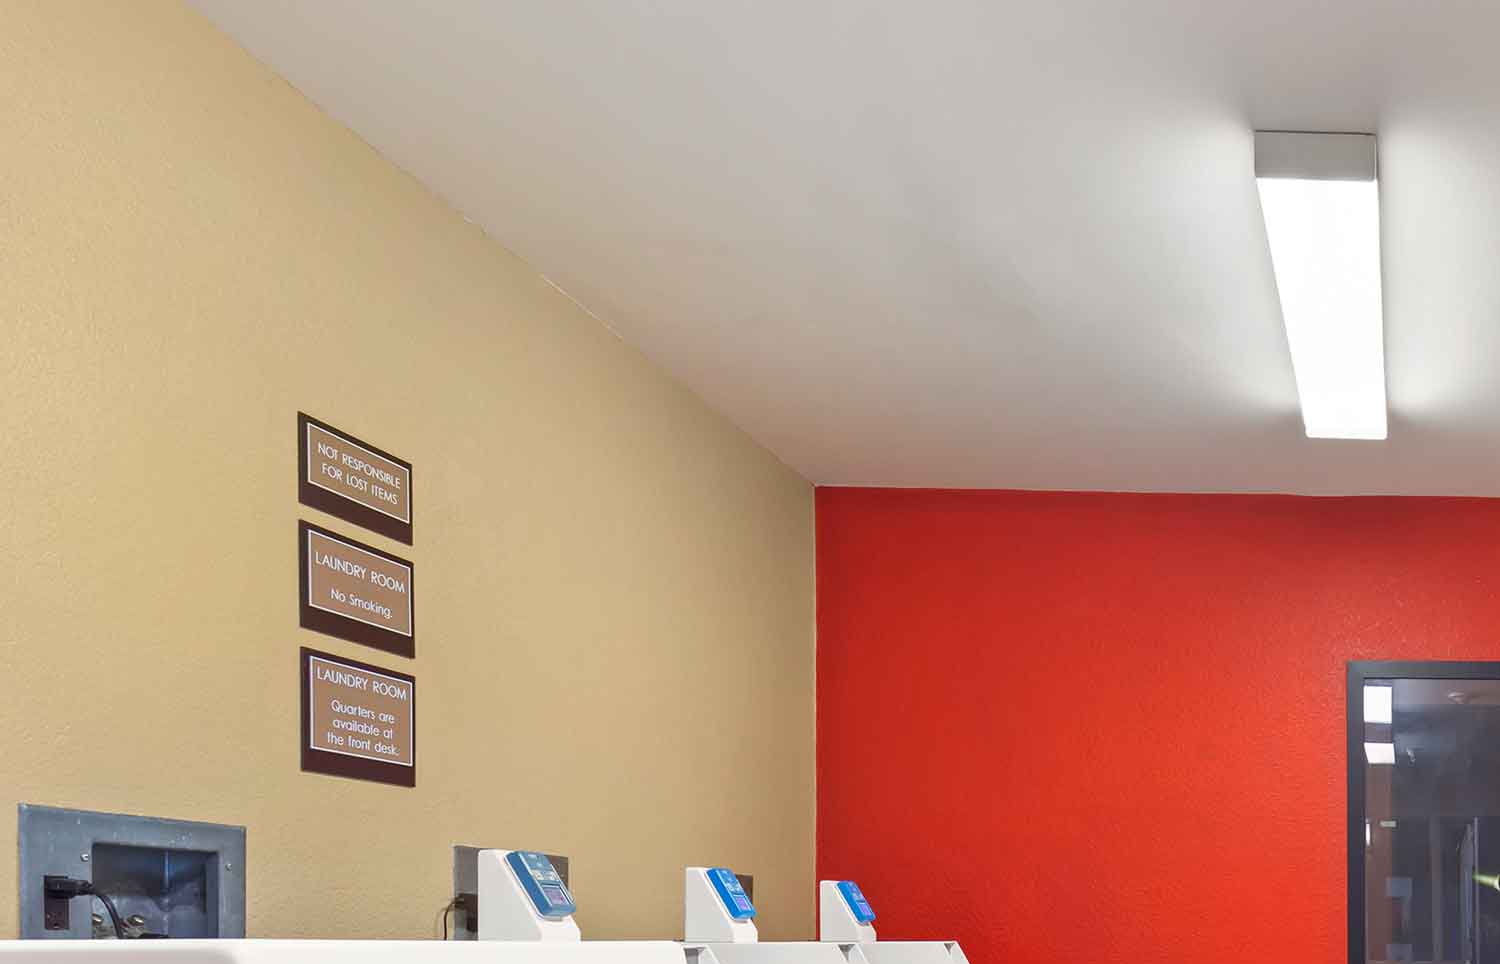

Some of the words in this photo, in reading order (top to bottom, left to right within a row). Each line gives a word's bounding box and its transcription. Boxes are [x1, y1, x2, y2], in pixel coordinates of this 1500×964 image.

[318, 441, 338, 460] NOT
[342, 453, 401, 489] RESPONSIBLE
[321, 464, 342, 481] FOR
[347, 474, 368, 492] LOST
[315, 552, 367, 580] LAUNDRY
[371, 571, 405, 593] ROOM
[331, 588, 346, 602] No
[316, 667, 369, 691] LAUNDRY
[372, 682, 407, 701] ROOM
[331, 699, 376, 720] Quarters
[379, 711, 395, 724] are
[327, 732, 344, 746] the
[348, 736, 371, 750] front
[332, 718, 380, 736] available
[383, 728, 393, 739] at
